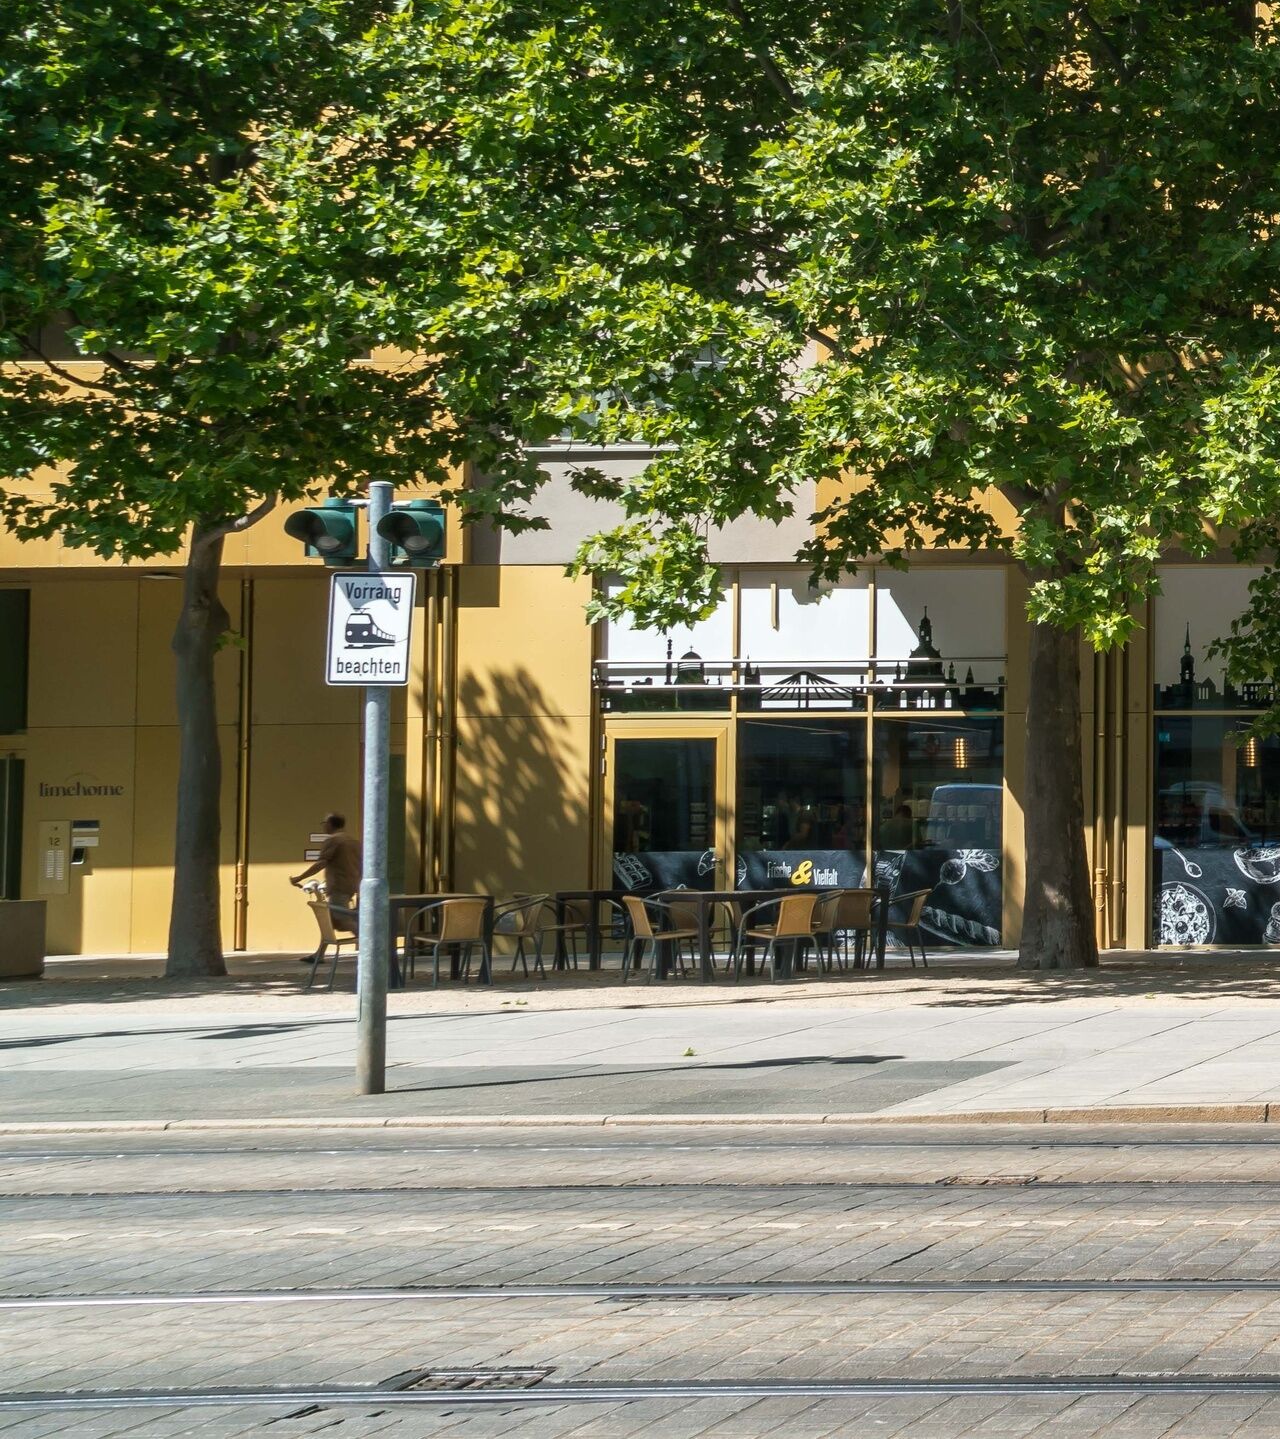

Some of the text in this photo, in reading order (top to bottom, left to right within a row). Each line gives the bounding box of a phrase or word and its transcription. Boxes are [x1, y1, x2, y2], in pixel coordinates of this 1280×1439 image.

[345, 582, 402, 604] Vorrang
[336, 656, 400, 675] beachten
[39, 782, 124, 798] limehome
[49, 837, 61, 847] 12
[767, 860, 839, 886] Frische & Vielfalt
